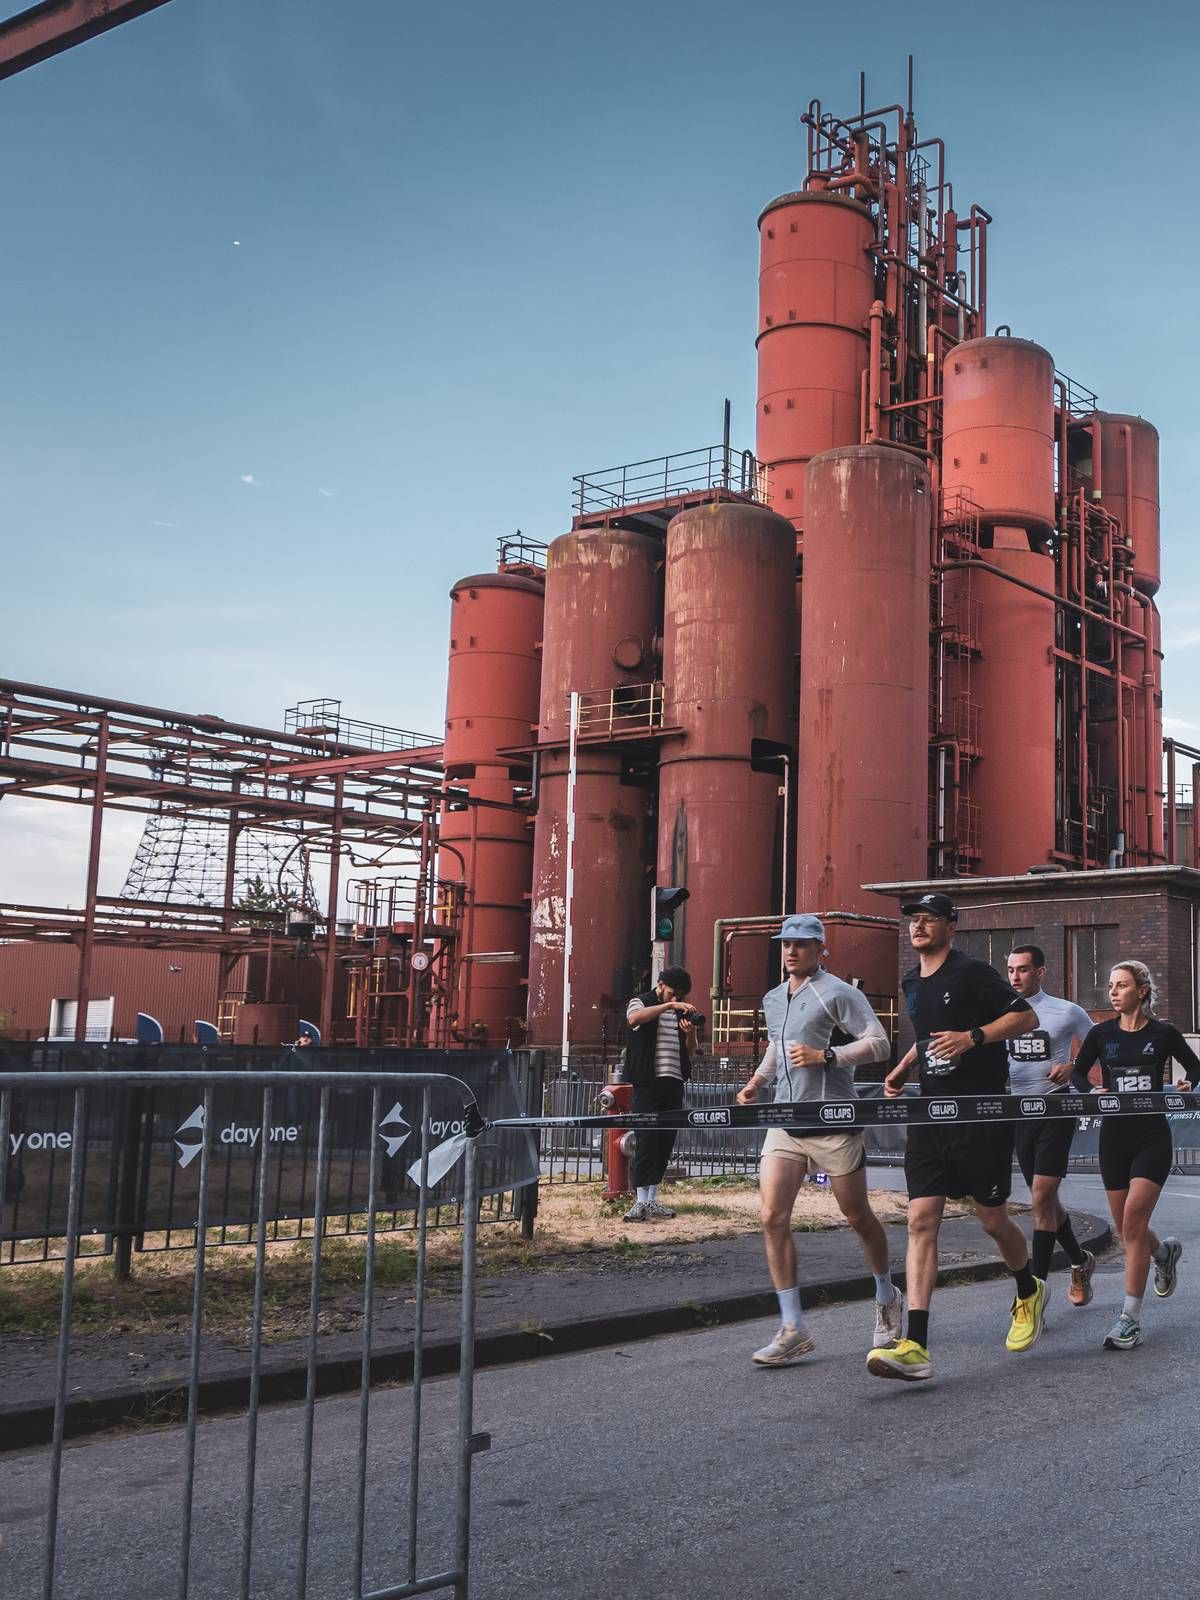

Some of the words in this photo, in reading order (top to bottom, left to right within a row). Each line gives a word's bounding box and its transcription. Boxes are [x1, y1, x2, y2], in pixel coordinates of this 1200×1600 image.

[1013, 1039, 1045, 1054] 158
[1116, 1075, 1152, 1092] 128
[27, 1132, 72, 1150] one
[221, 1122, 260, 1147] day
